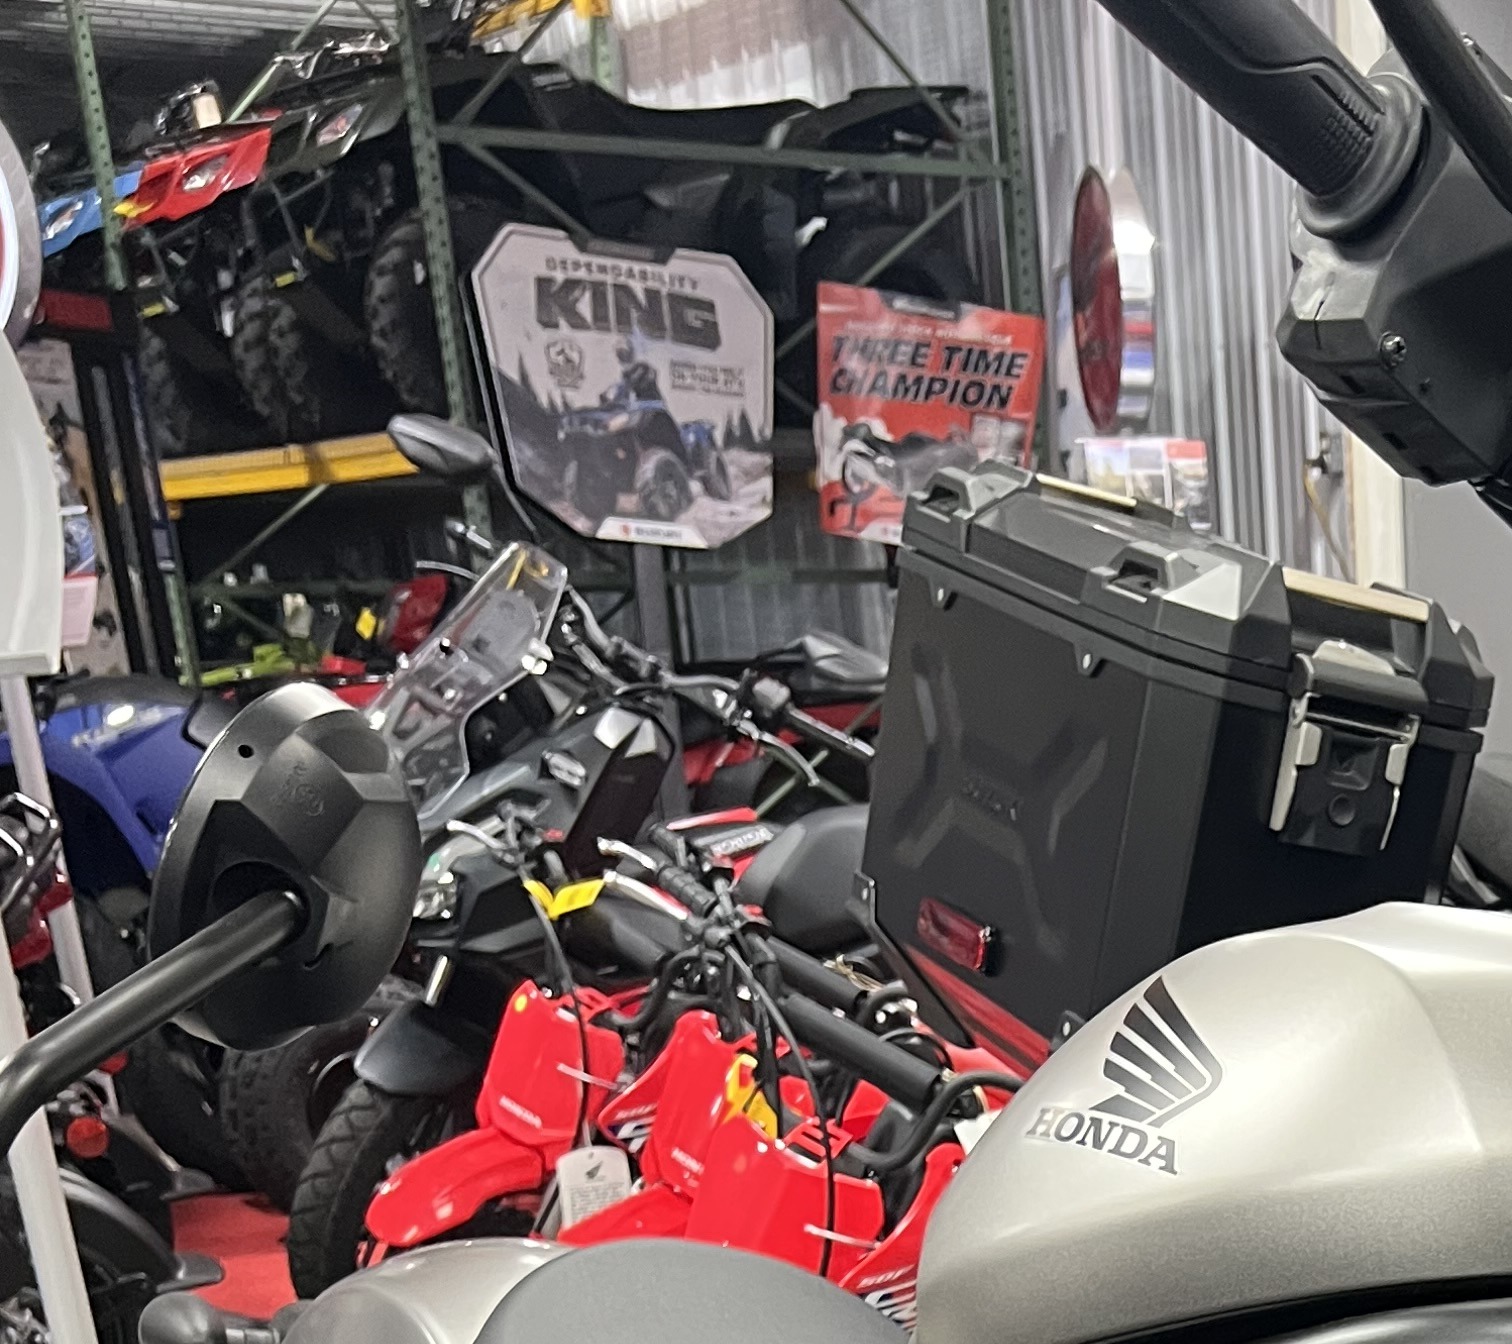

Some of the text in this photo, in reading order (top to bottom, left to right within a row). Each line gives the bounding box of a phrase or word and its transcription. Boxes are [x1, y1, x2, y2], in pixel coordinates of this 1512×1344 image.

[545, 257, 699, 290] DEPENDABILITY
[534, 275, 722, 352] KING
[831, 335, 1028, 379] THREE TIME
[829, 367, 1014, 411] CHAMPION
[1025, 1106, 1178, 1176] HONDA
